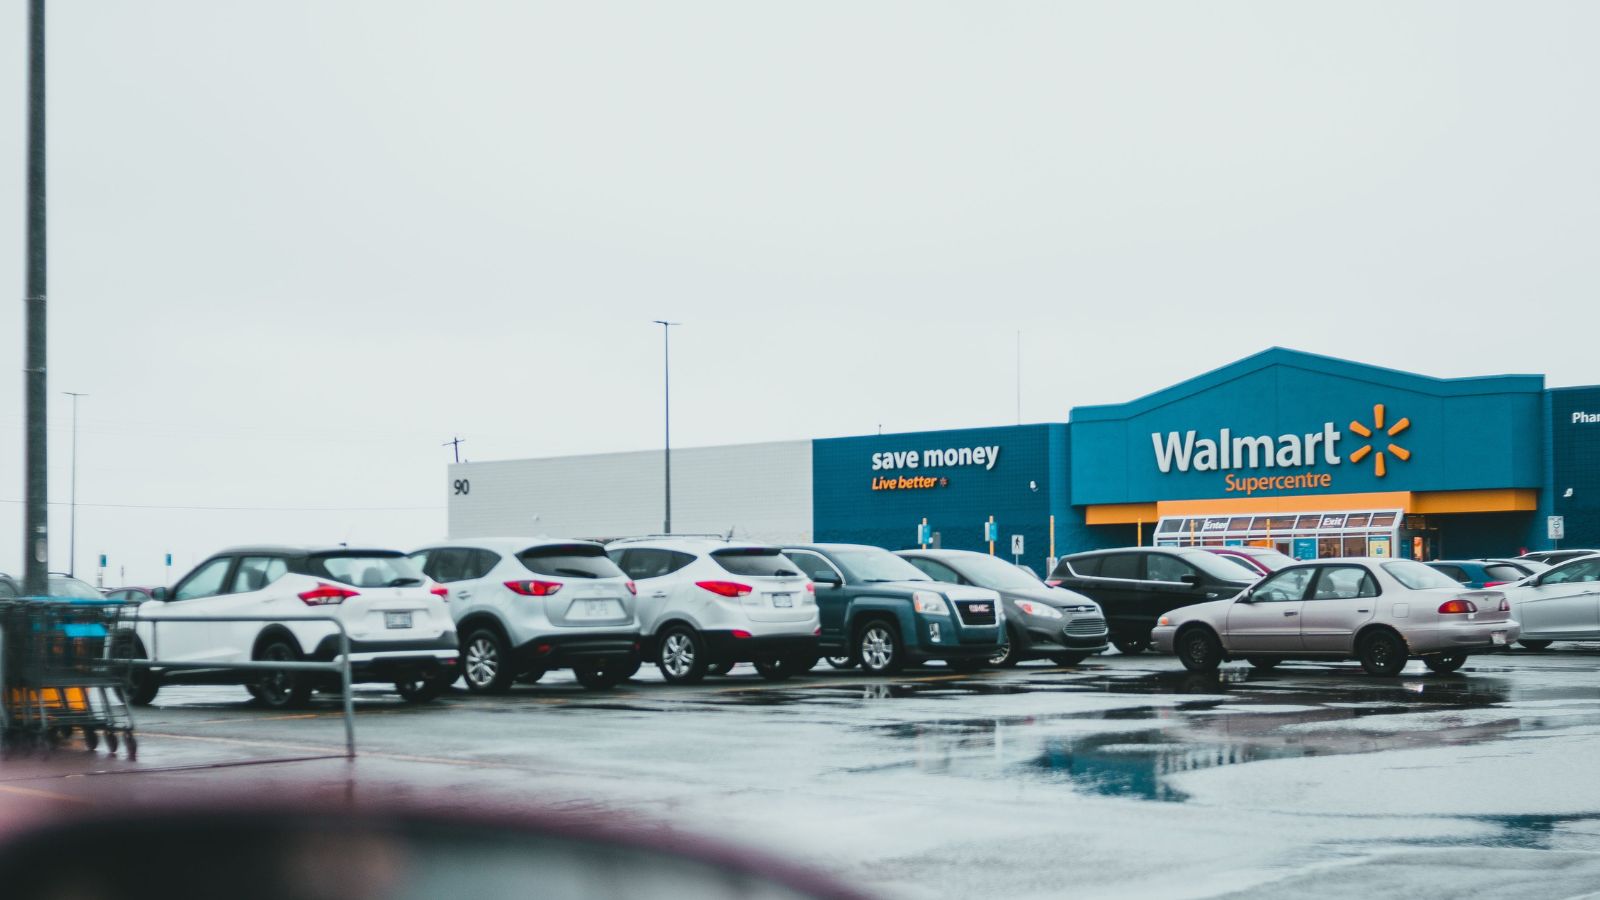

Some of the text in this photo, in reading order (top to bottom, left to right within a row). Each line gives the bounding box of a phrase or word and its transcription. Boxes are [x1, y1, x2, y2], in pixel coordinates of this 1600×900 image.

[1151, 422, 1341, 473] Walmart
[872, 446, 999, 470] save money
[454, 479, 470, 495] 90
[872, 475, 937, 490] Live better
[1225, 472, 1331, 494] Supercentre
[1205, 520, 1228, 529] Enter
[1322, 516, 1344, 526] Exit
